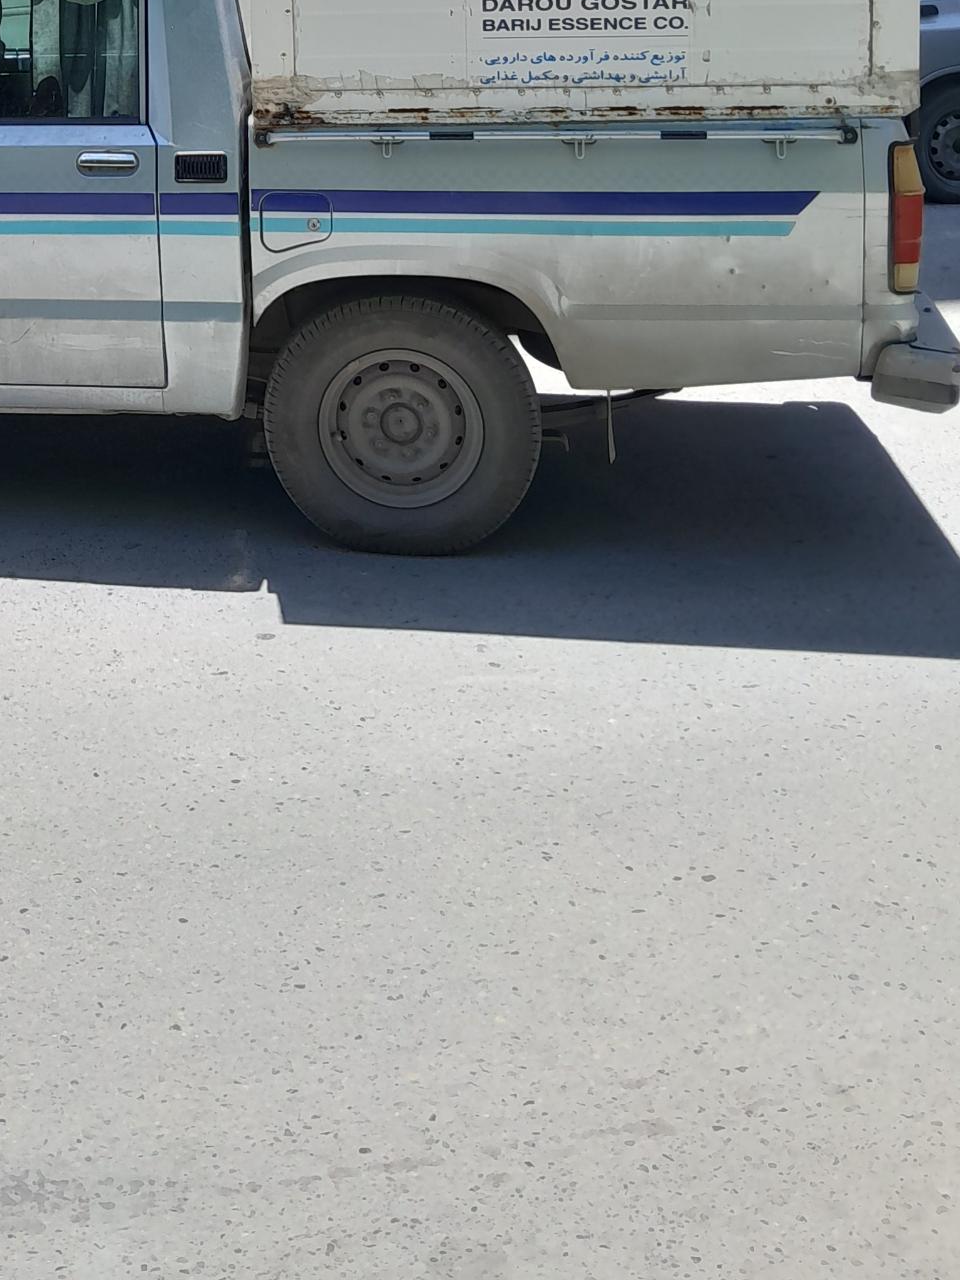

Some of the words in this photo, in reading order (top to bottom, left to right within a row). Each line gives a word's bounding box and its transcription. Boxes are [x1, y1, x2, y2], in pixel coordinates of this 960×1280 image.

[481, 18, 542, 32] BARIJ
[548, 17, 647, 30] ESSENCE
[652, 16, 689, 30] CO.
[530, 50, 556, 64] های
[612, 49, 651, 62] کننده
[649, 49, 687, 65] توزیع
[478, 71, 520, 85] غذایی
[520, 70, 561, 85] مکمل
[571, 70, 627, 85] بهداشتی
[634, 69, 687, 85] آرایشی
